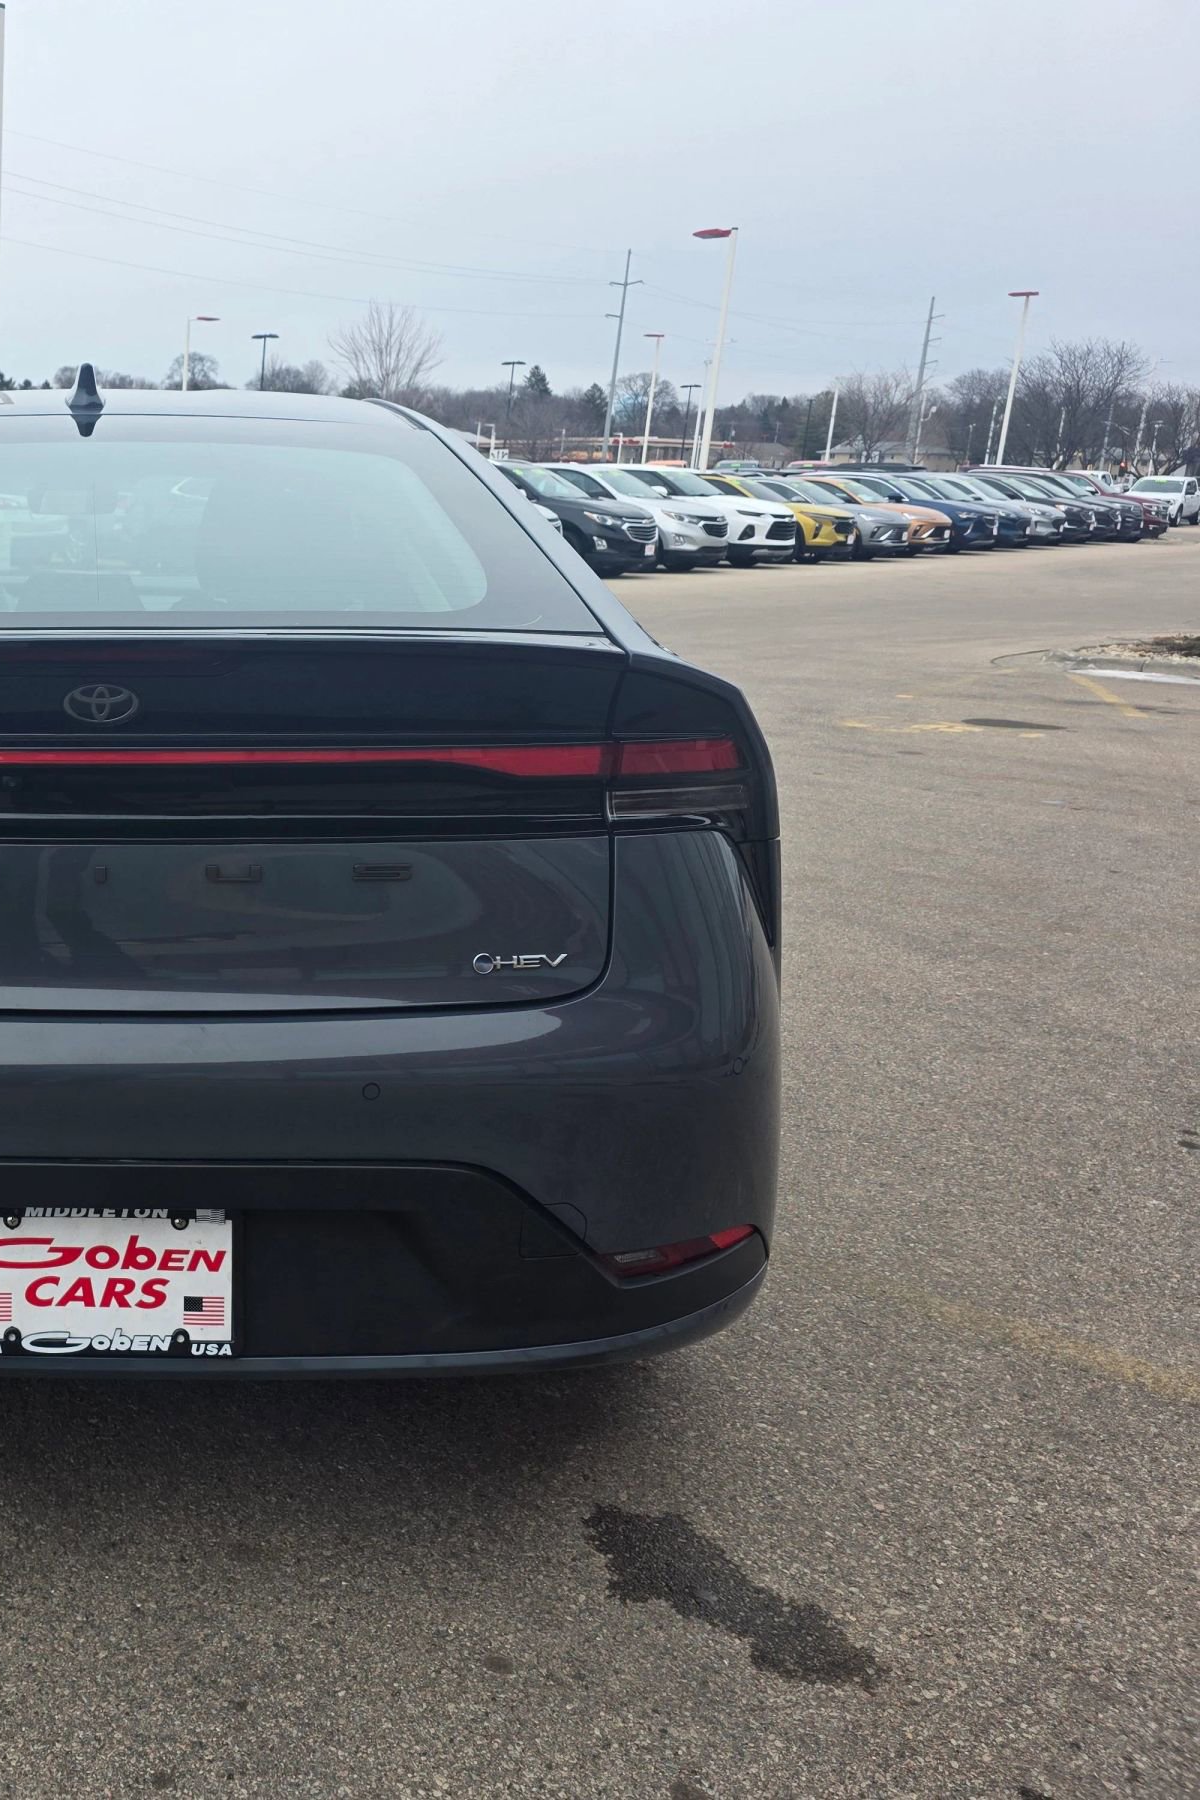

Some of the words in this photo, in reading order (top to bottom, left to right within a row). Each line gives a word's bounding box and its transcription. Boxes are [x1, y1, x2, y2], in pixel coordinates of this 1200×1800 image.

[495, 953, 568, 969] HEV
[24, 1207, 169, 1218] MIDDLETON
[25, 1276, 171, 1310] CARS
[191, 1343, 233, 1356] USA
